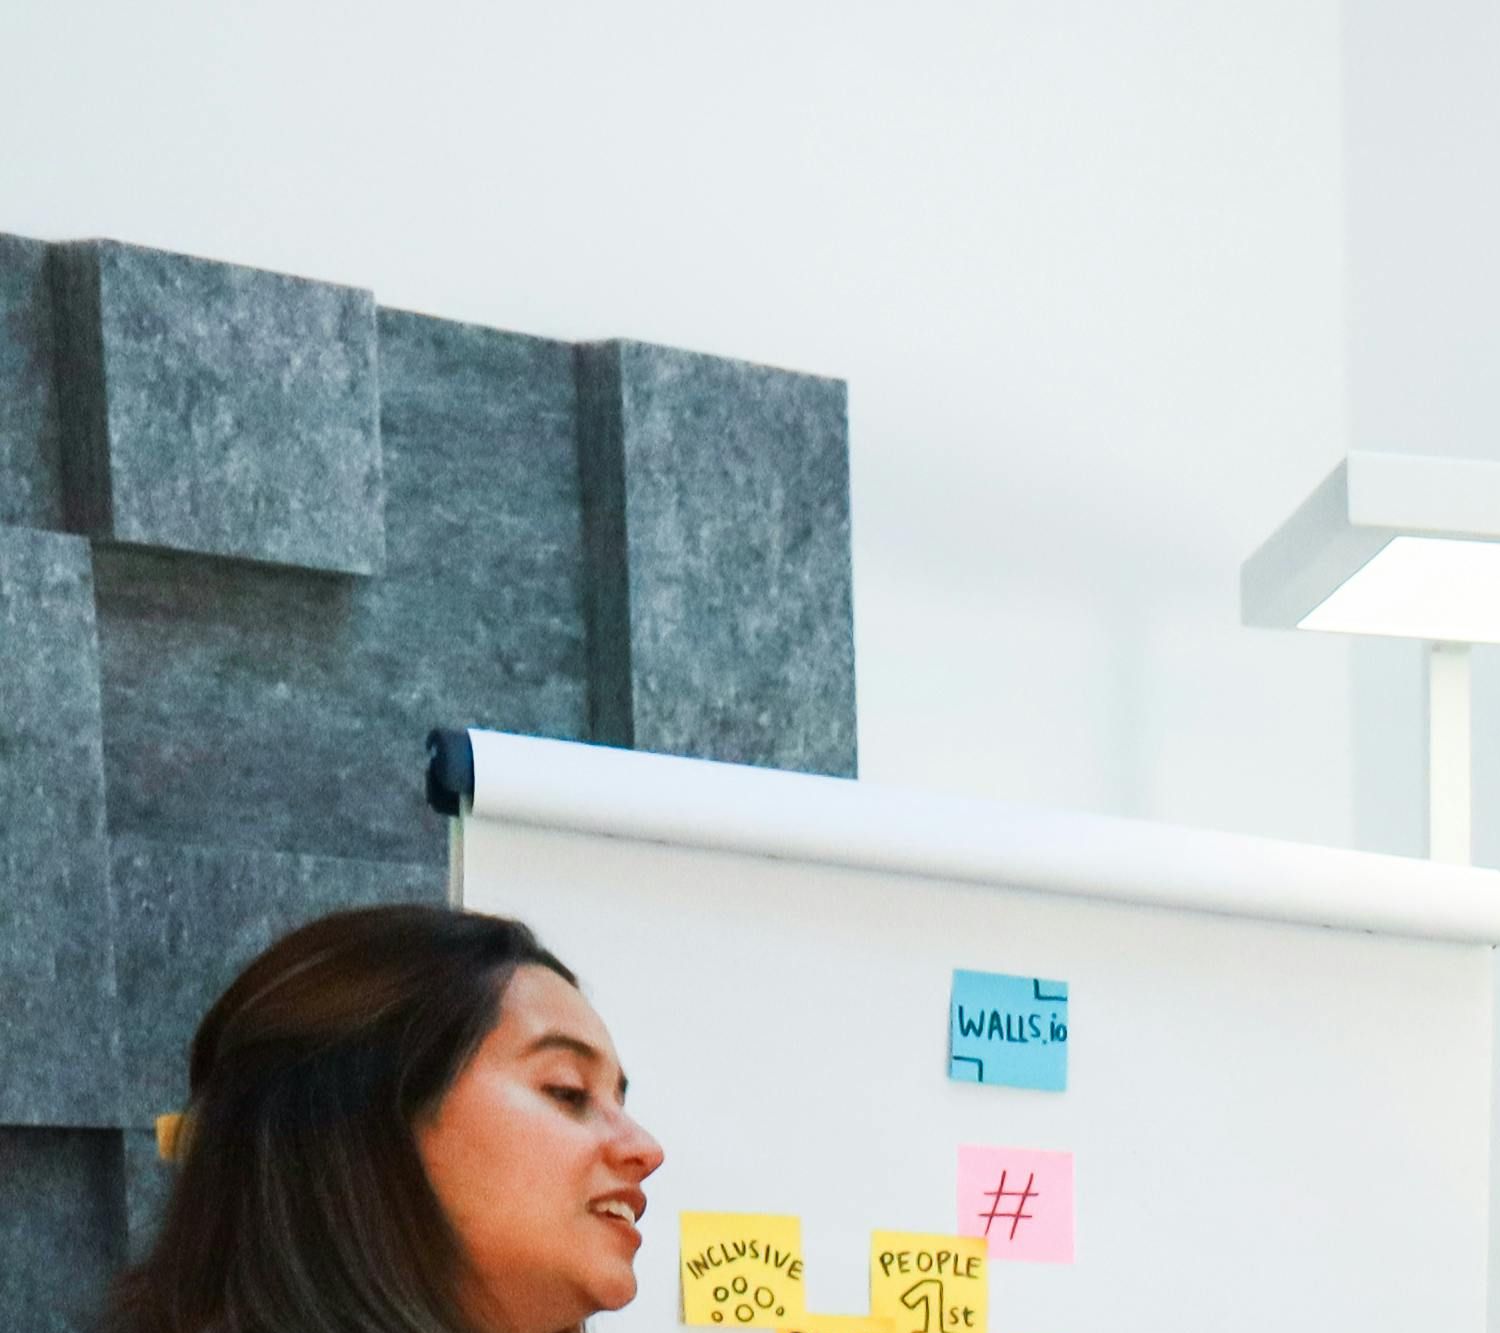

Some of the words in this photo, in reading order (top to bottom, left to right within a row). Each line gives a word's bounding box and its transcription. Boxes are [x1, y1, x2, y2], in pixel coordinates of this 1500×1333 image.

[958, 1004, 1068, 1045] WALLS.io
[686, 1239, 804, 1281] INCLUSIVE
[879, 1250, 982, 1280] PEOPLE
